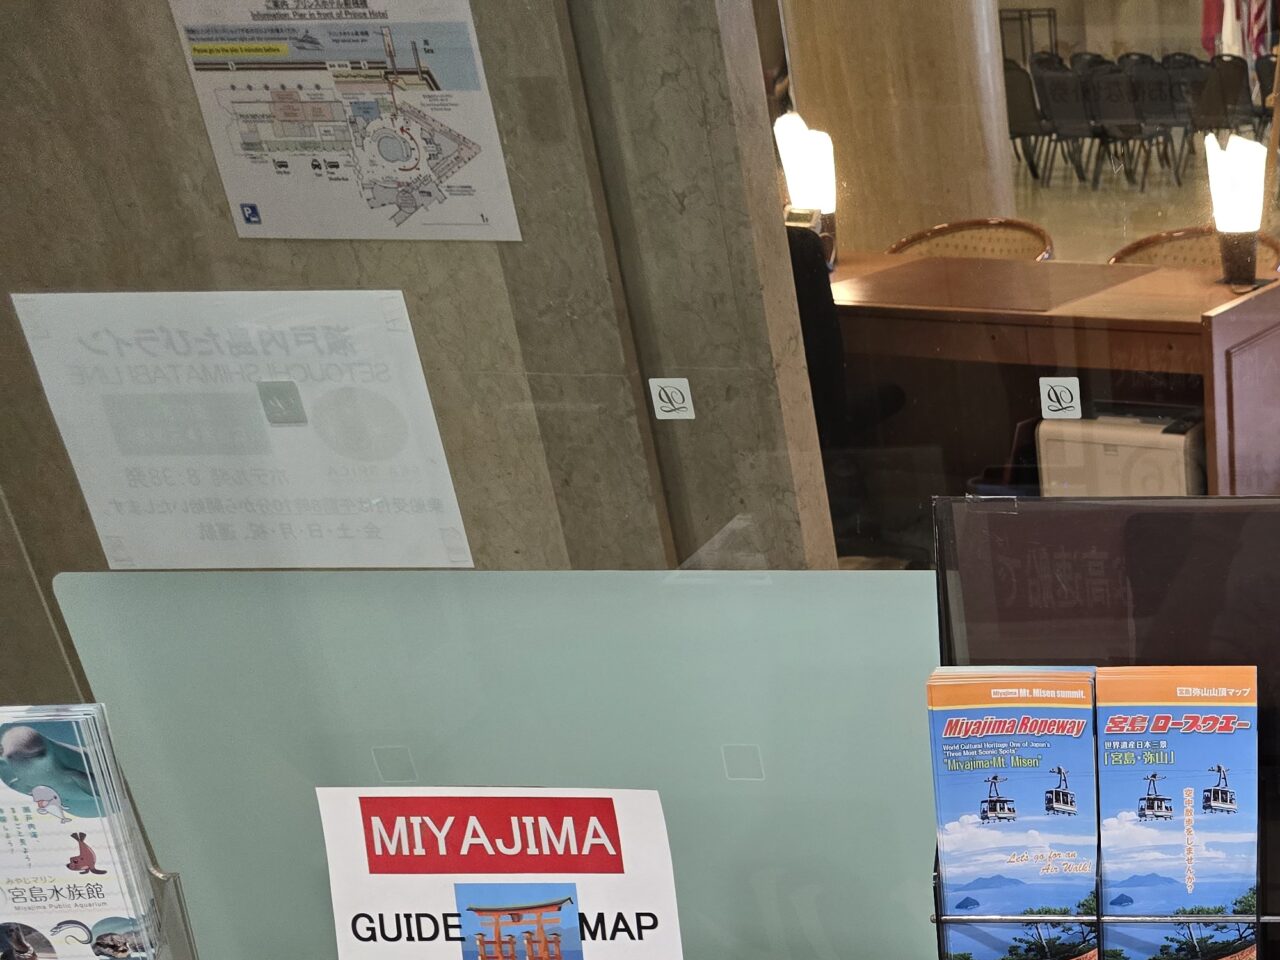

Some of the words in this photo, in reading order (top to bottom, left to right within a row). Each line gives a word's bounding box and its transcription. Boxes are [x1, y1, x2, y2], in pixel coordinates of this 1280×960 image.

[345, 11, 366, 19] Prince
[369, 11, 387, 19] Hotel
[1019, 689, 1032, 698] Mt.
[1033, 689, 1056, 698] Misen
[943, 716, 1018, 738] Miyajima
[1017, 715, 1087, 737] Ropeway
[1104, 715, 1149, 733] 宮島
[984, 742, 1008, 750] Heritage
[1104, 741, 1168, 750] 世界遺産日本三景
[371, 815, 617, 857] MIYAJIMA
[1034, 855, 1045, 865] go
[1047, 851, 1062, 865] for
[1040, 863, 1059, 875] Air
[1063, 861, 1092, 873] Walk!
[9, 883, 105, 903] 宮島水族館
[48, 902, 72, 910] Public
[74, 901, 108, 909] Aquarium
[351, 912, 465, 943] GUIDE
[579, 912, 660, 942] MAP
